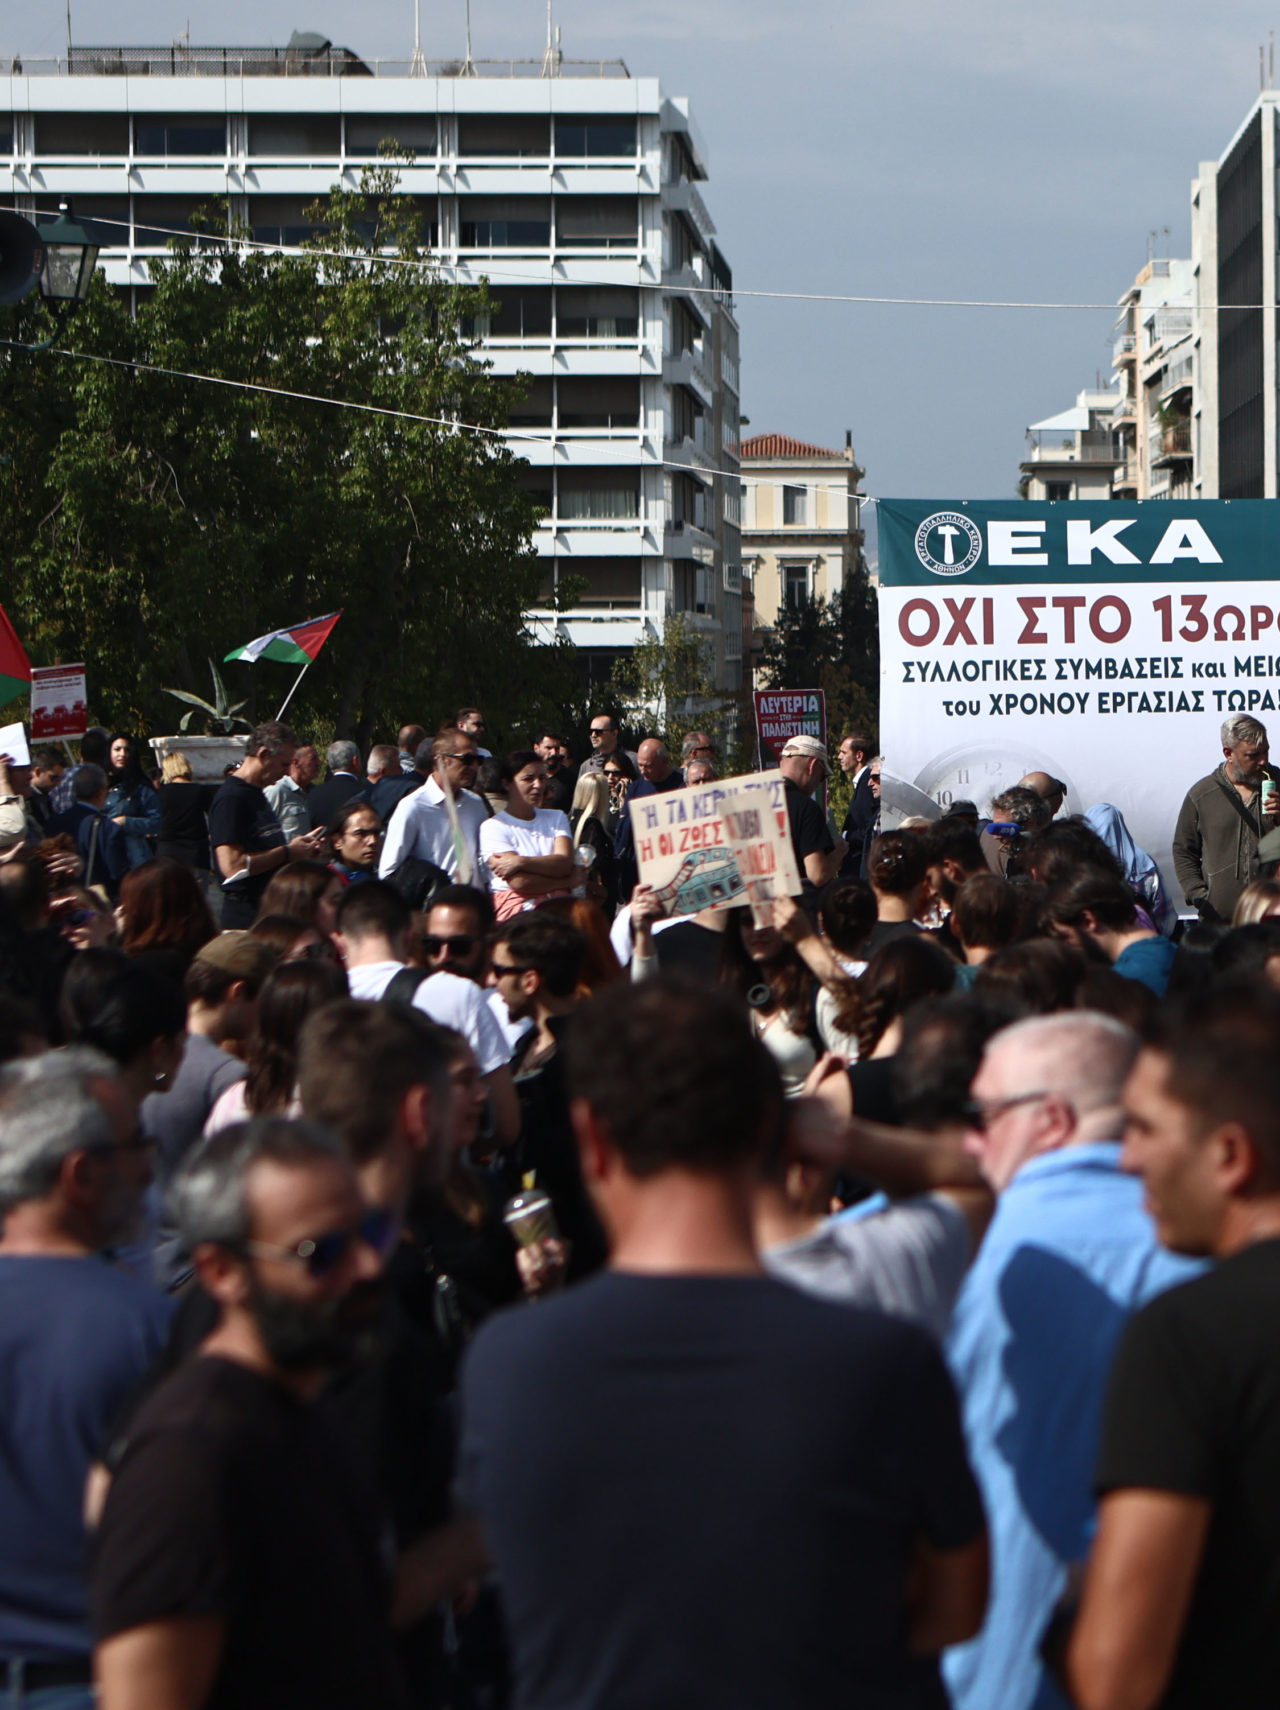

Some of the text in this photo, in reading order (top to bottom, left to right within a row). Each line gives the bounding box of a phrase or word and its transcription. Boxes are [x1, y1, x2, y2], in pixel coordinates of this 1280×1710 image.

[987, 519, 1224, 566] ΕΚΑ
[898, 597, 995, 647] ΟΧΙ
[1016, 595, 1132, 645] ΣΤΟ
[902, 658, 1047, 683] ΣΥΛΛΟΓΙΚΕΣ
[1055, 656, 1183, 680] ΣΥΜΒΑΣΕΙΣ
[1191, 660, 1226, 679] και
[760, 695, 819, 714] ΛΕΥΤΕΡΙΑ
[942, 698, 981, 717] του
[989, 692, 1090, 716] ΧΡΟΝΟΥ
[1098, 690, 1205, 713] ΕΡΓΑΣΙΑΣ
[761, 720, 819, 737] ΠΑΛΑΙΣΤΙΝΗ
[957, 769, 970, 785] 11
[936, 790, 953, 806] 10
[665, 799, 687, 825] ΤΑ
